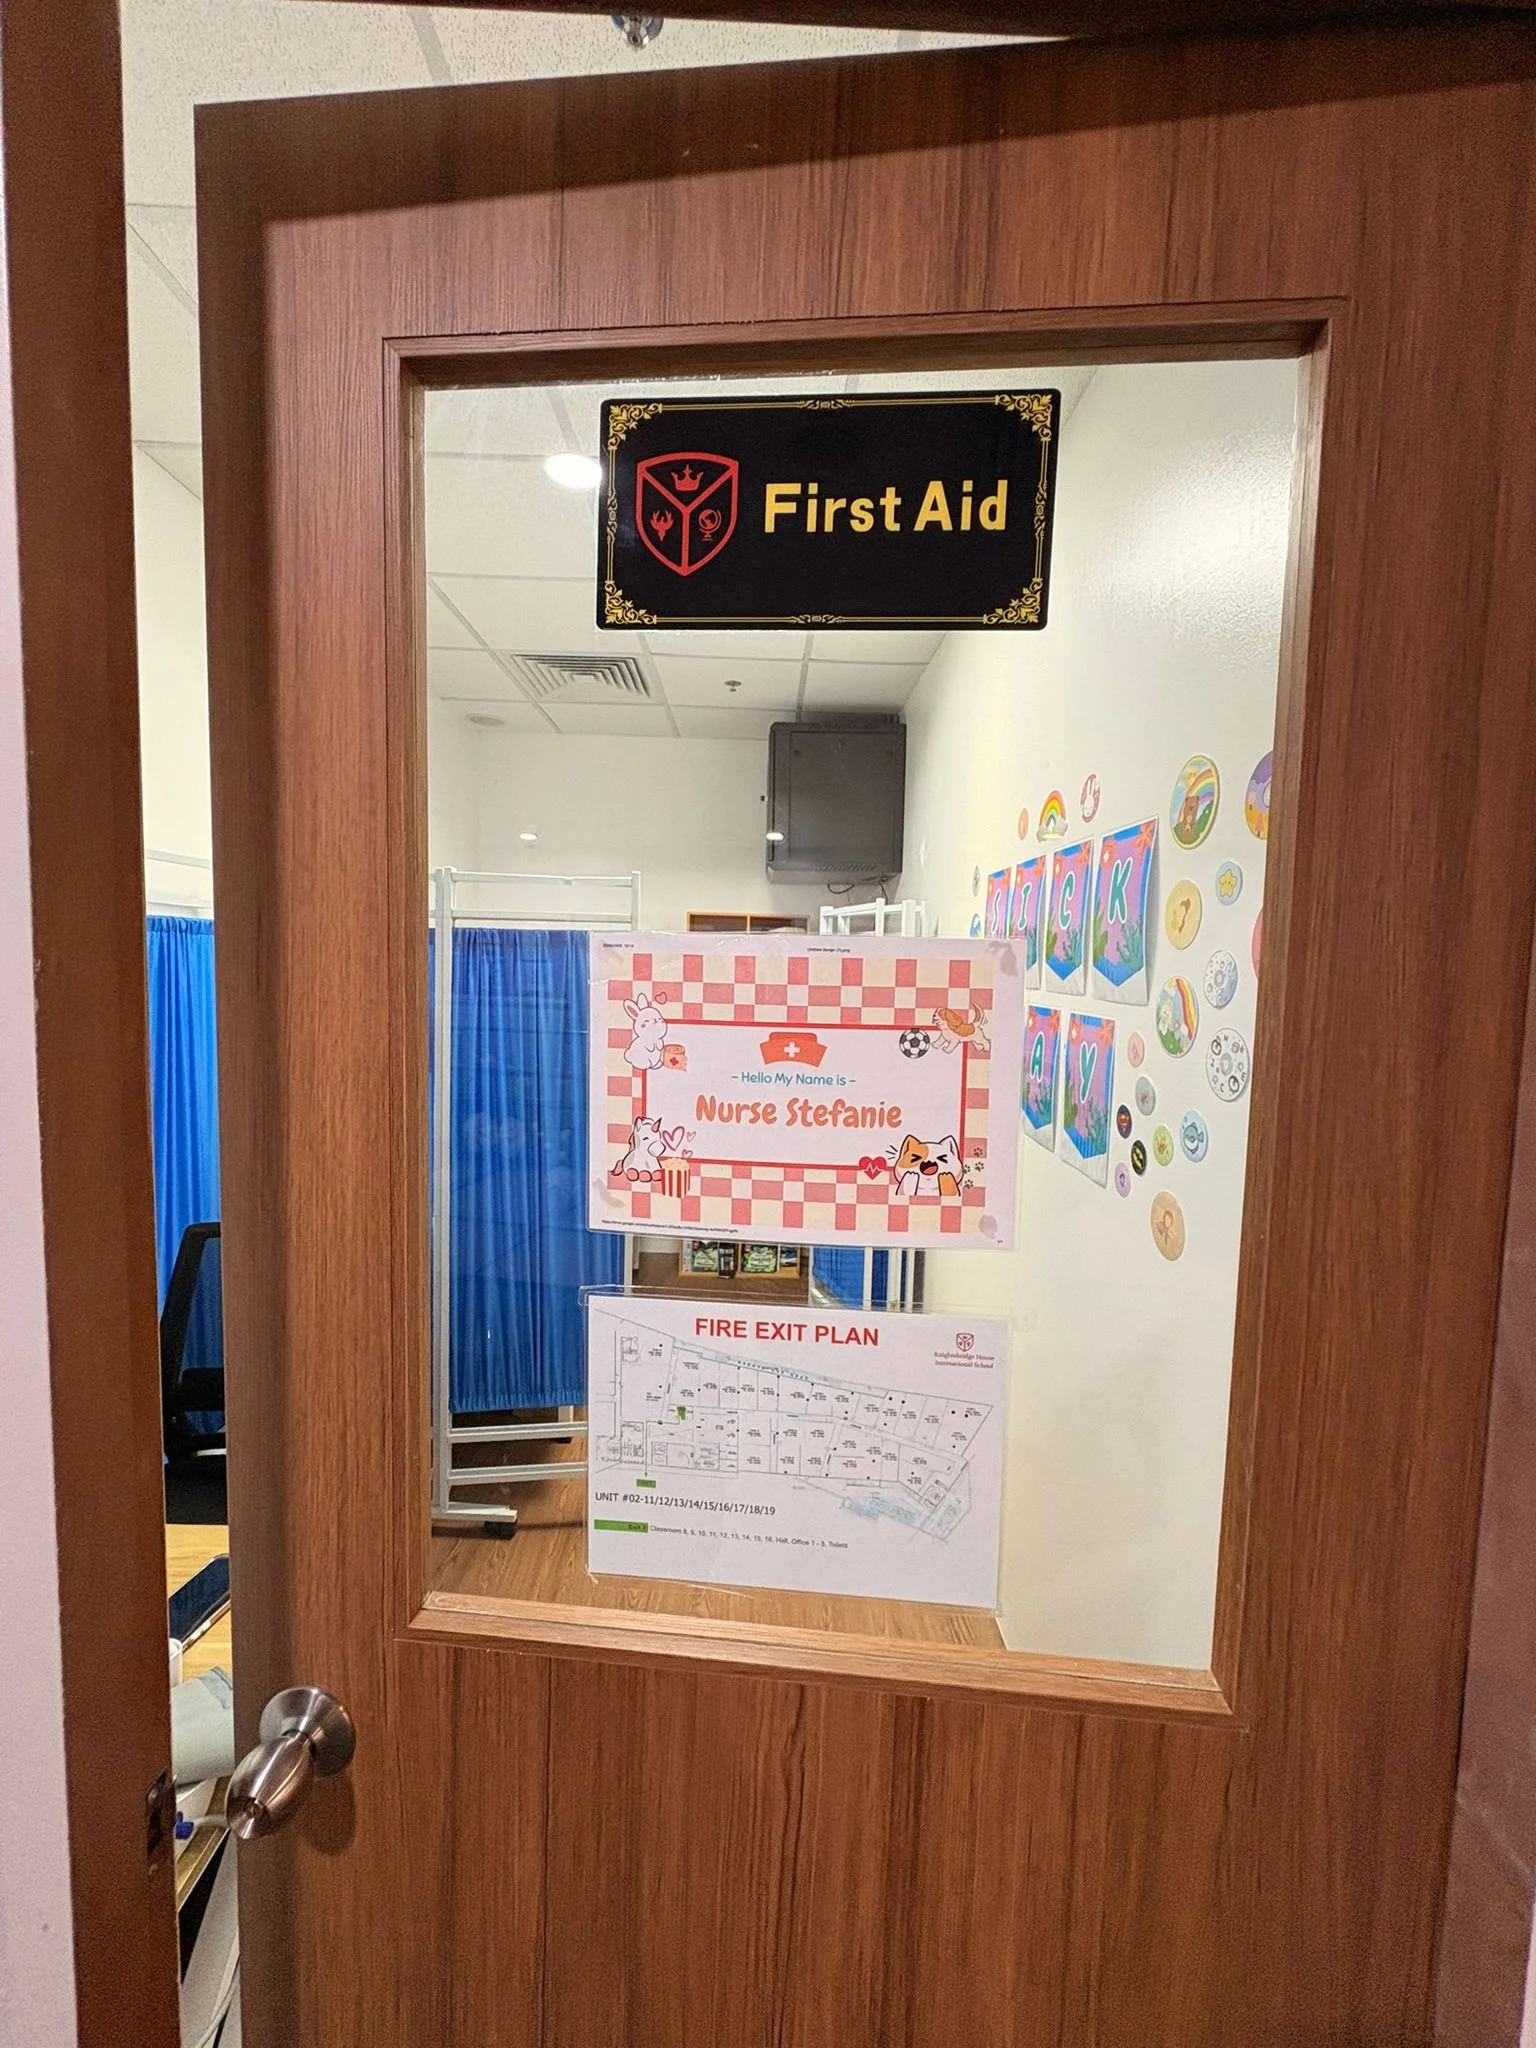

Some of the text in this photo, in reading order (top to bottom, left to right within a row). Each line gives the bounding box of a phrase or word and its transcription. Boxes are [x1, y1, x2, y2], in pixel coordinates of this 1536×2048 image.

[764, 479, 1009, 533] First Aid
[990, 856, 1133, 934] SICK
[741, 1072, 772, 1084] Hello
[775, 1073, 793, 1087] My
[796, 1074, 833, 1086] Name
[836, 1074, 847, 1086] is
[1029, 1031, 1099, 1104] AY
[695, 1094, 903, 1129] Nurse Stefanie
[695, 1317, 879, 1346] FIRE EXIT PLAN
[595, 1492, 776, 1516] UNIT #02-11/12/13/14/15/16/17/18/19
[650, 1525, 682, 1534] Classroom
[791, 1538, 810, 1546] Office
[828, 1541, 849, 1549] Toilets
